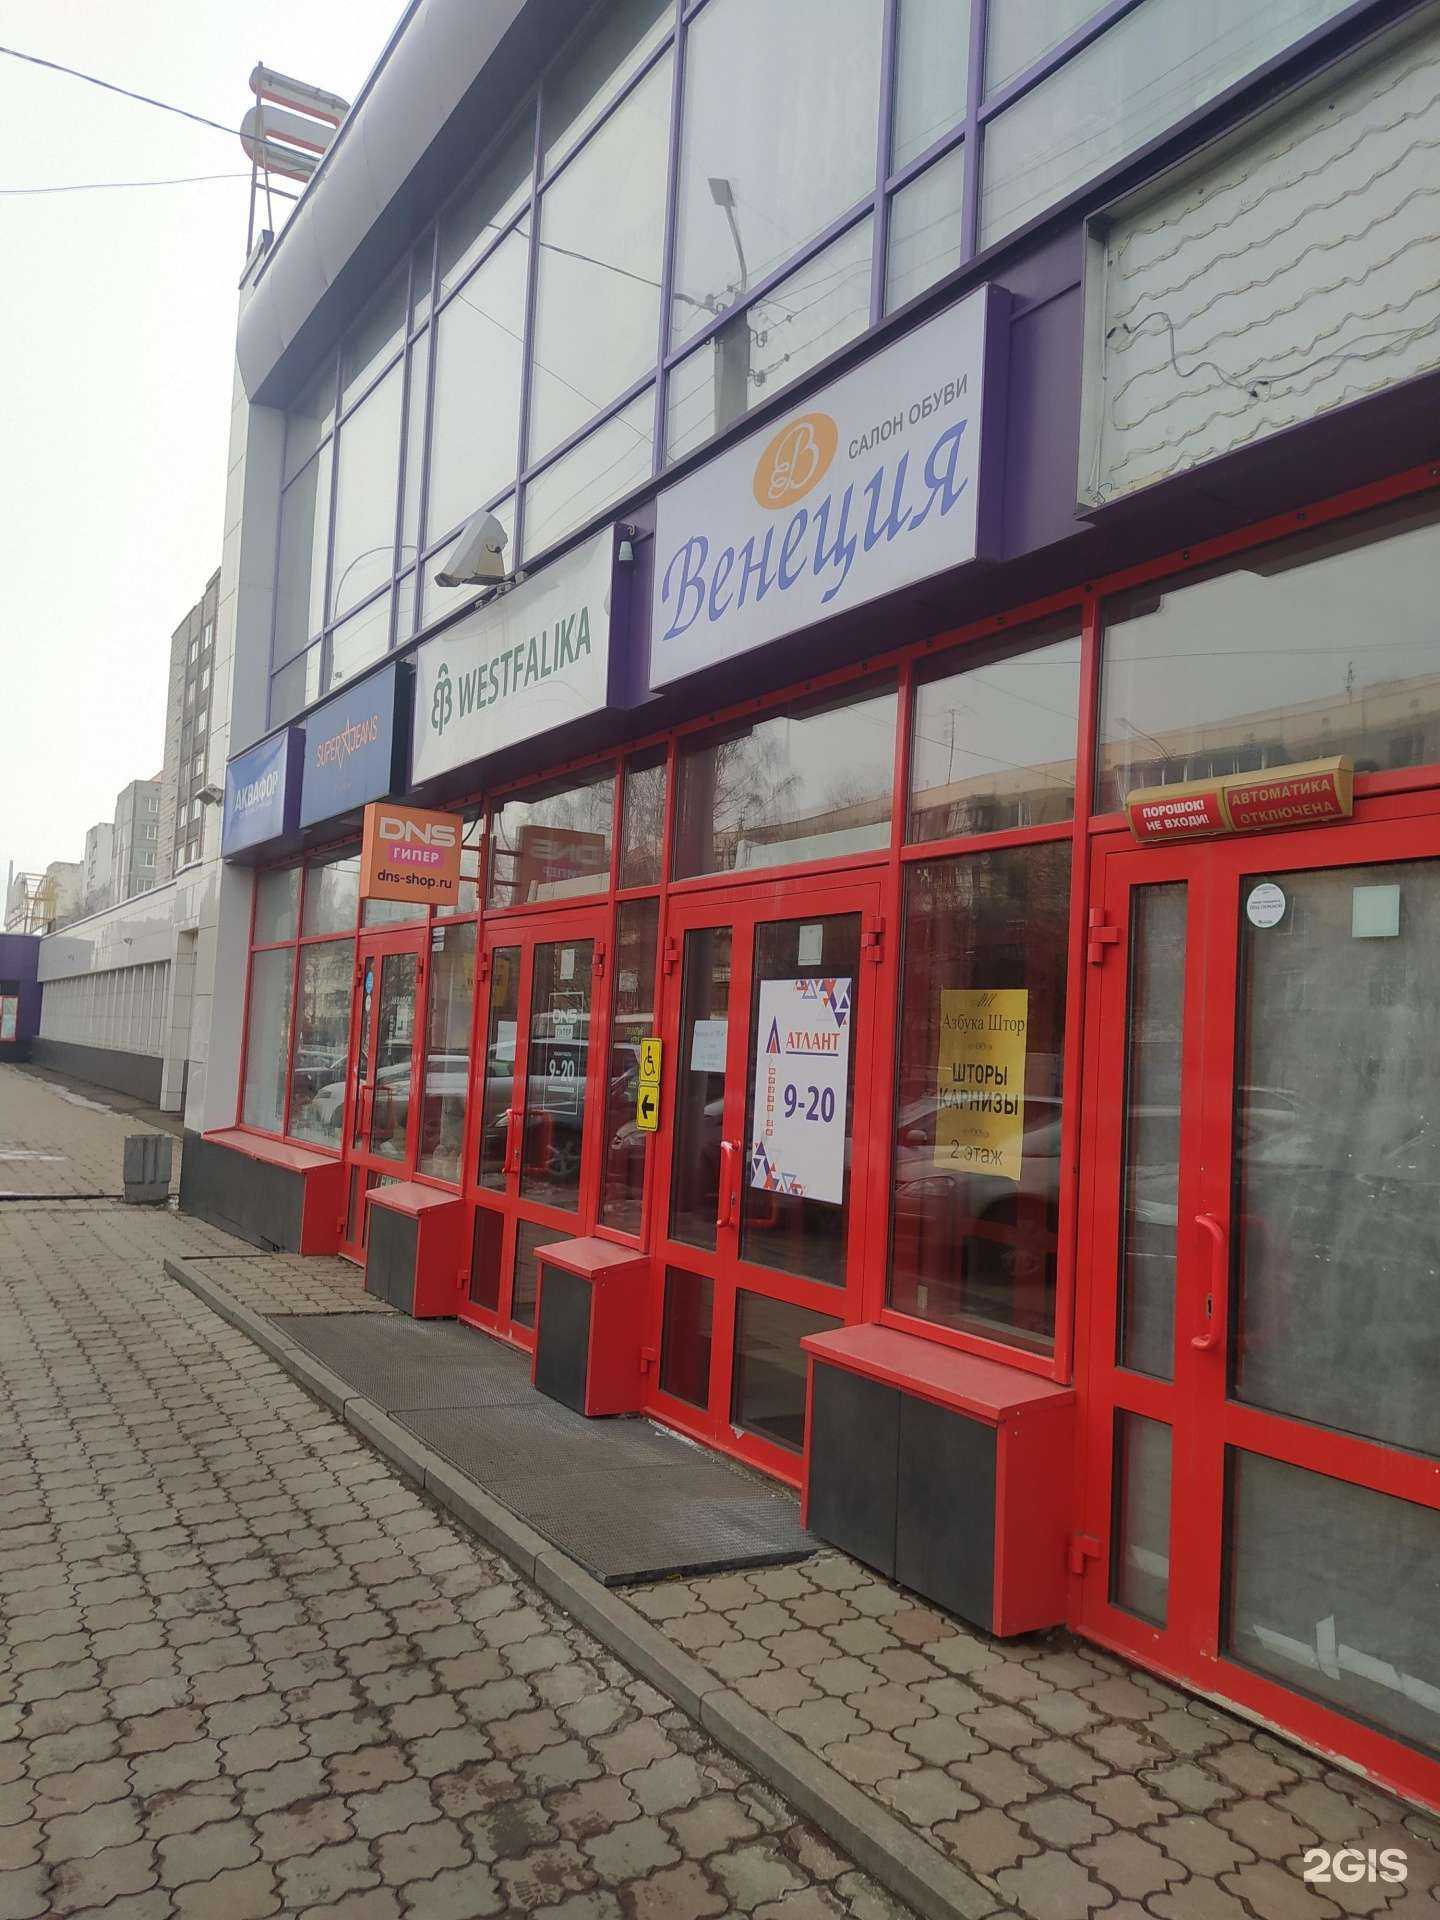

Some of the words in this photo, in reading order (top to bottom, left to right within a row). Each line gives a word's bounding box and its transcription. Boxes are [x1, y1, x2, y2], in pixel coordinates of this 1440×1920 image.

[848, 416, 904, 460] САЛОН
[908, 374, 968, 425] ОБУВИ
[661, 418, 969, 641] Венеция
[458, 606, 591, 718] WESTFALIKA
[236, 771, 279, 810] АКВАФОР
[1232, 779, 1331, 807] АВТОМАТИКА
[1142, 800, 1205, 818] ПОРОШОК!
[1240, 801, 1335, 823] ОТКЛЮЧЕНА
[379, 816, 456, 848] DNS
[1146, 820, 1163, 831] НЕ
[1164, 813, 1210, 829] ВХОДИ!
[393, 847, 440, 863] ГИПЕР
[377, 869, 452, 889] dns-shop.ru
[943, 1013, 984, 1035] Азбука
[988, 1015, 1025, 1037] Штор
[786, 1031, 841, 1051] АТЛАНТ
[549, 1060, 575, 1081] 9-20
[952, 1062, 1008, 1086] ШТОРЫ
[784, 1083, 835, 1123] 9-20
[939, 1087, 1019, 1116] КАРНИЗЫ
[950, 1139, 960, 1159] 2
[963, 1147, 1003, 1166] этаж
